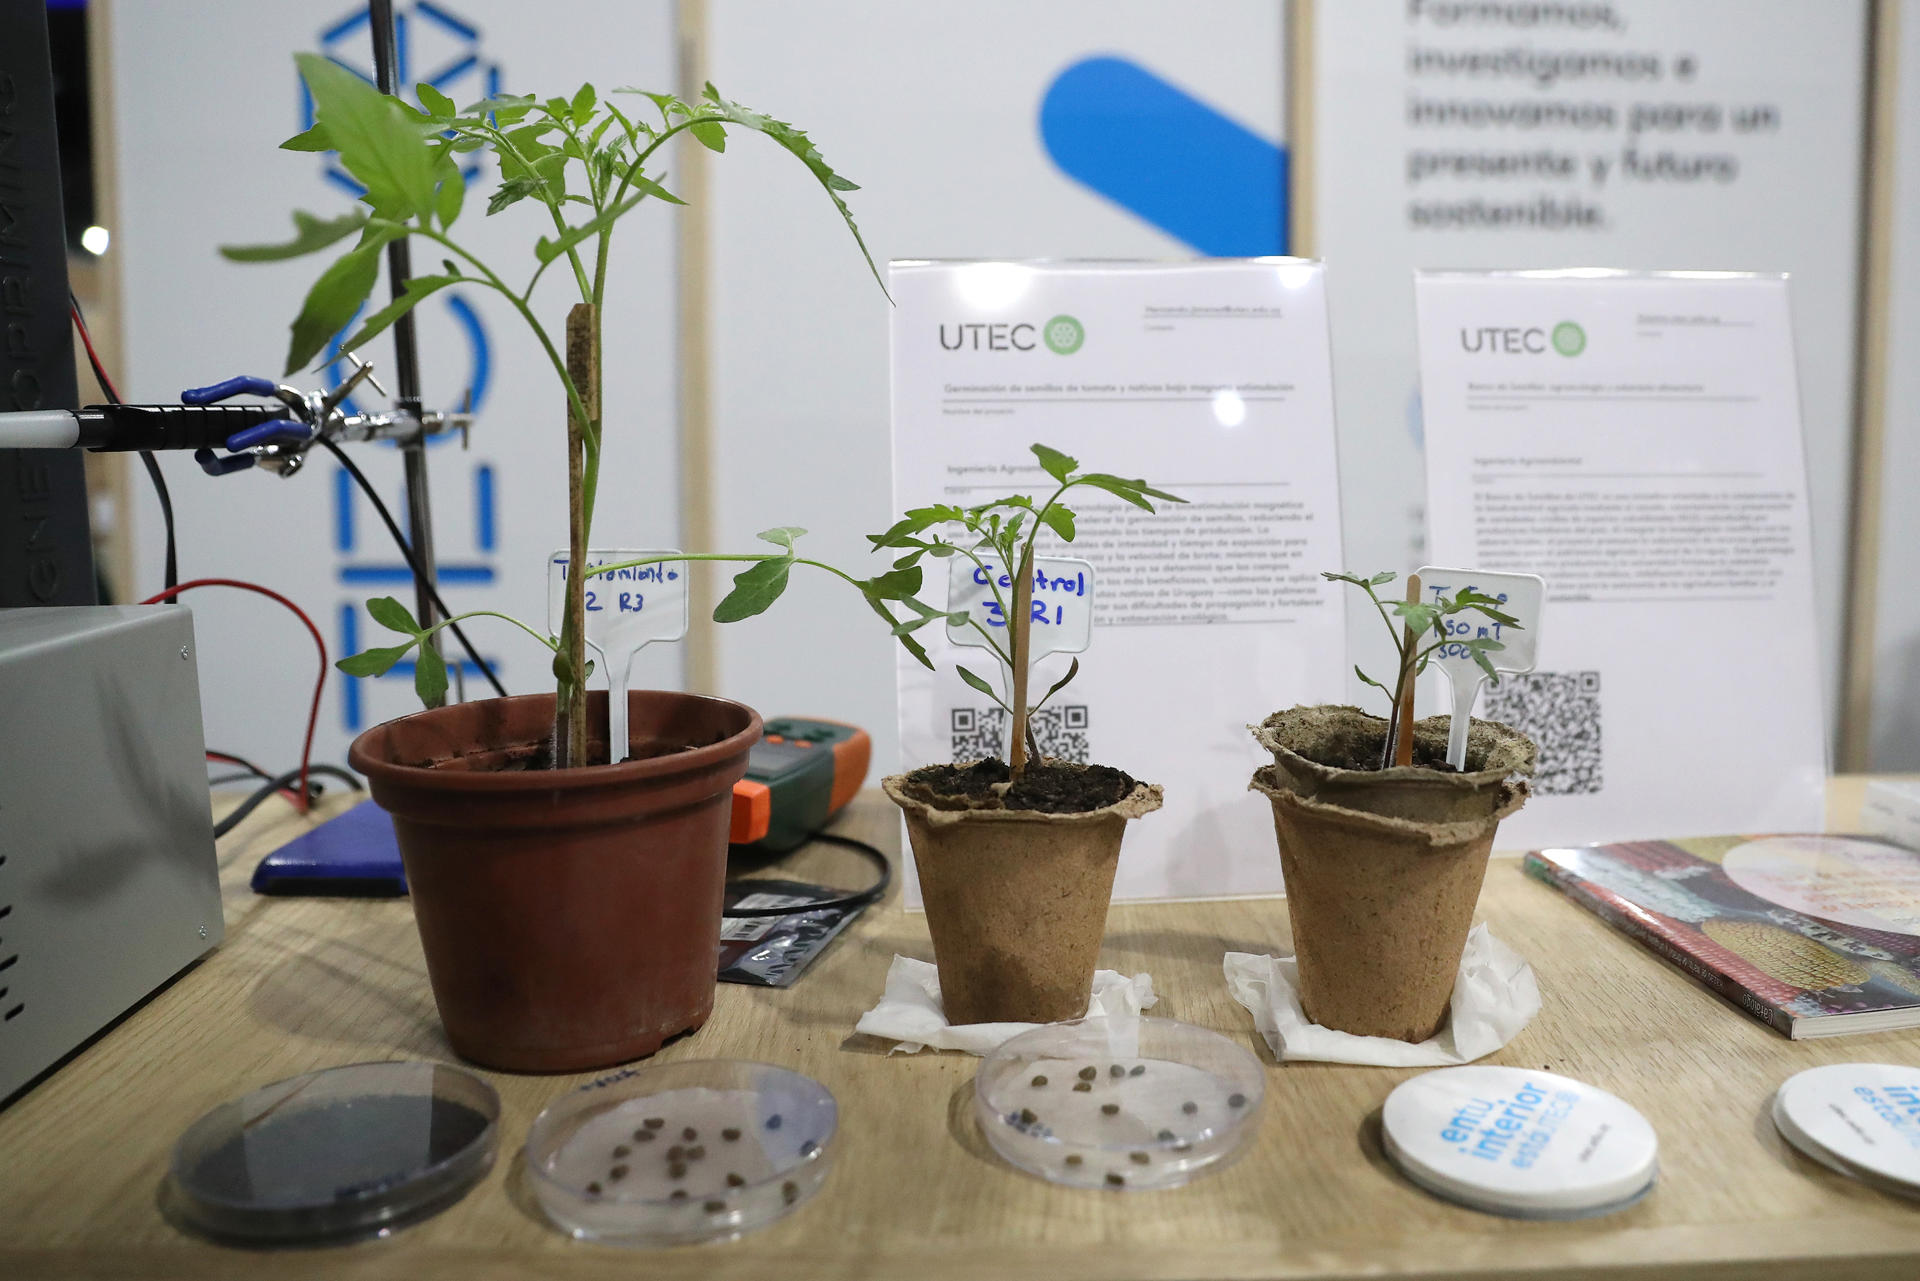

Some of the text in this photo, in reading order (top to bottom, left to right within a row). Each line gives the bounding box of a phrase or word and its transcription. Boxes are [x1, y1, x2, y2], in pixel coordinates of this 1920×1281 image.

[1409, 44, 1698, 87] investigamos e
[1409, 92, 1779, 139] innovamos para un
[1407, 146, 1739, 188] presente y futuro
[940, 322, 1037, 351] UTEC
[1461, 328, 1546, 354] UTEC
[585, 591, 603, 611] 2
[1458, 1081, 1548, 1161] interior
